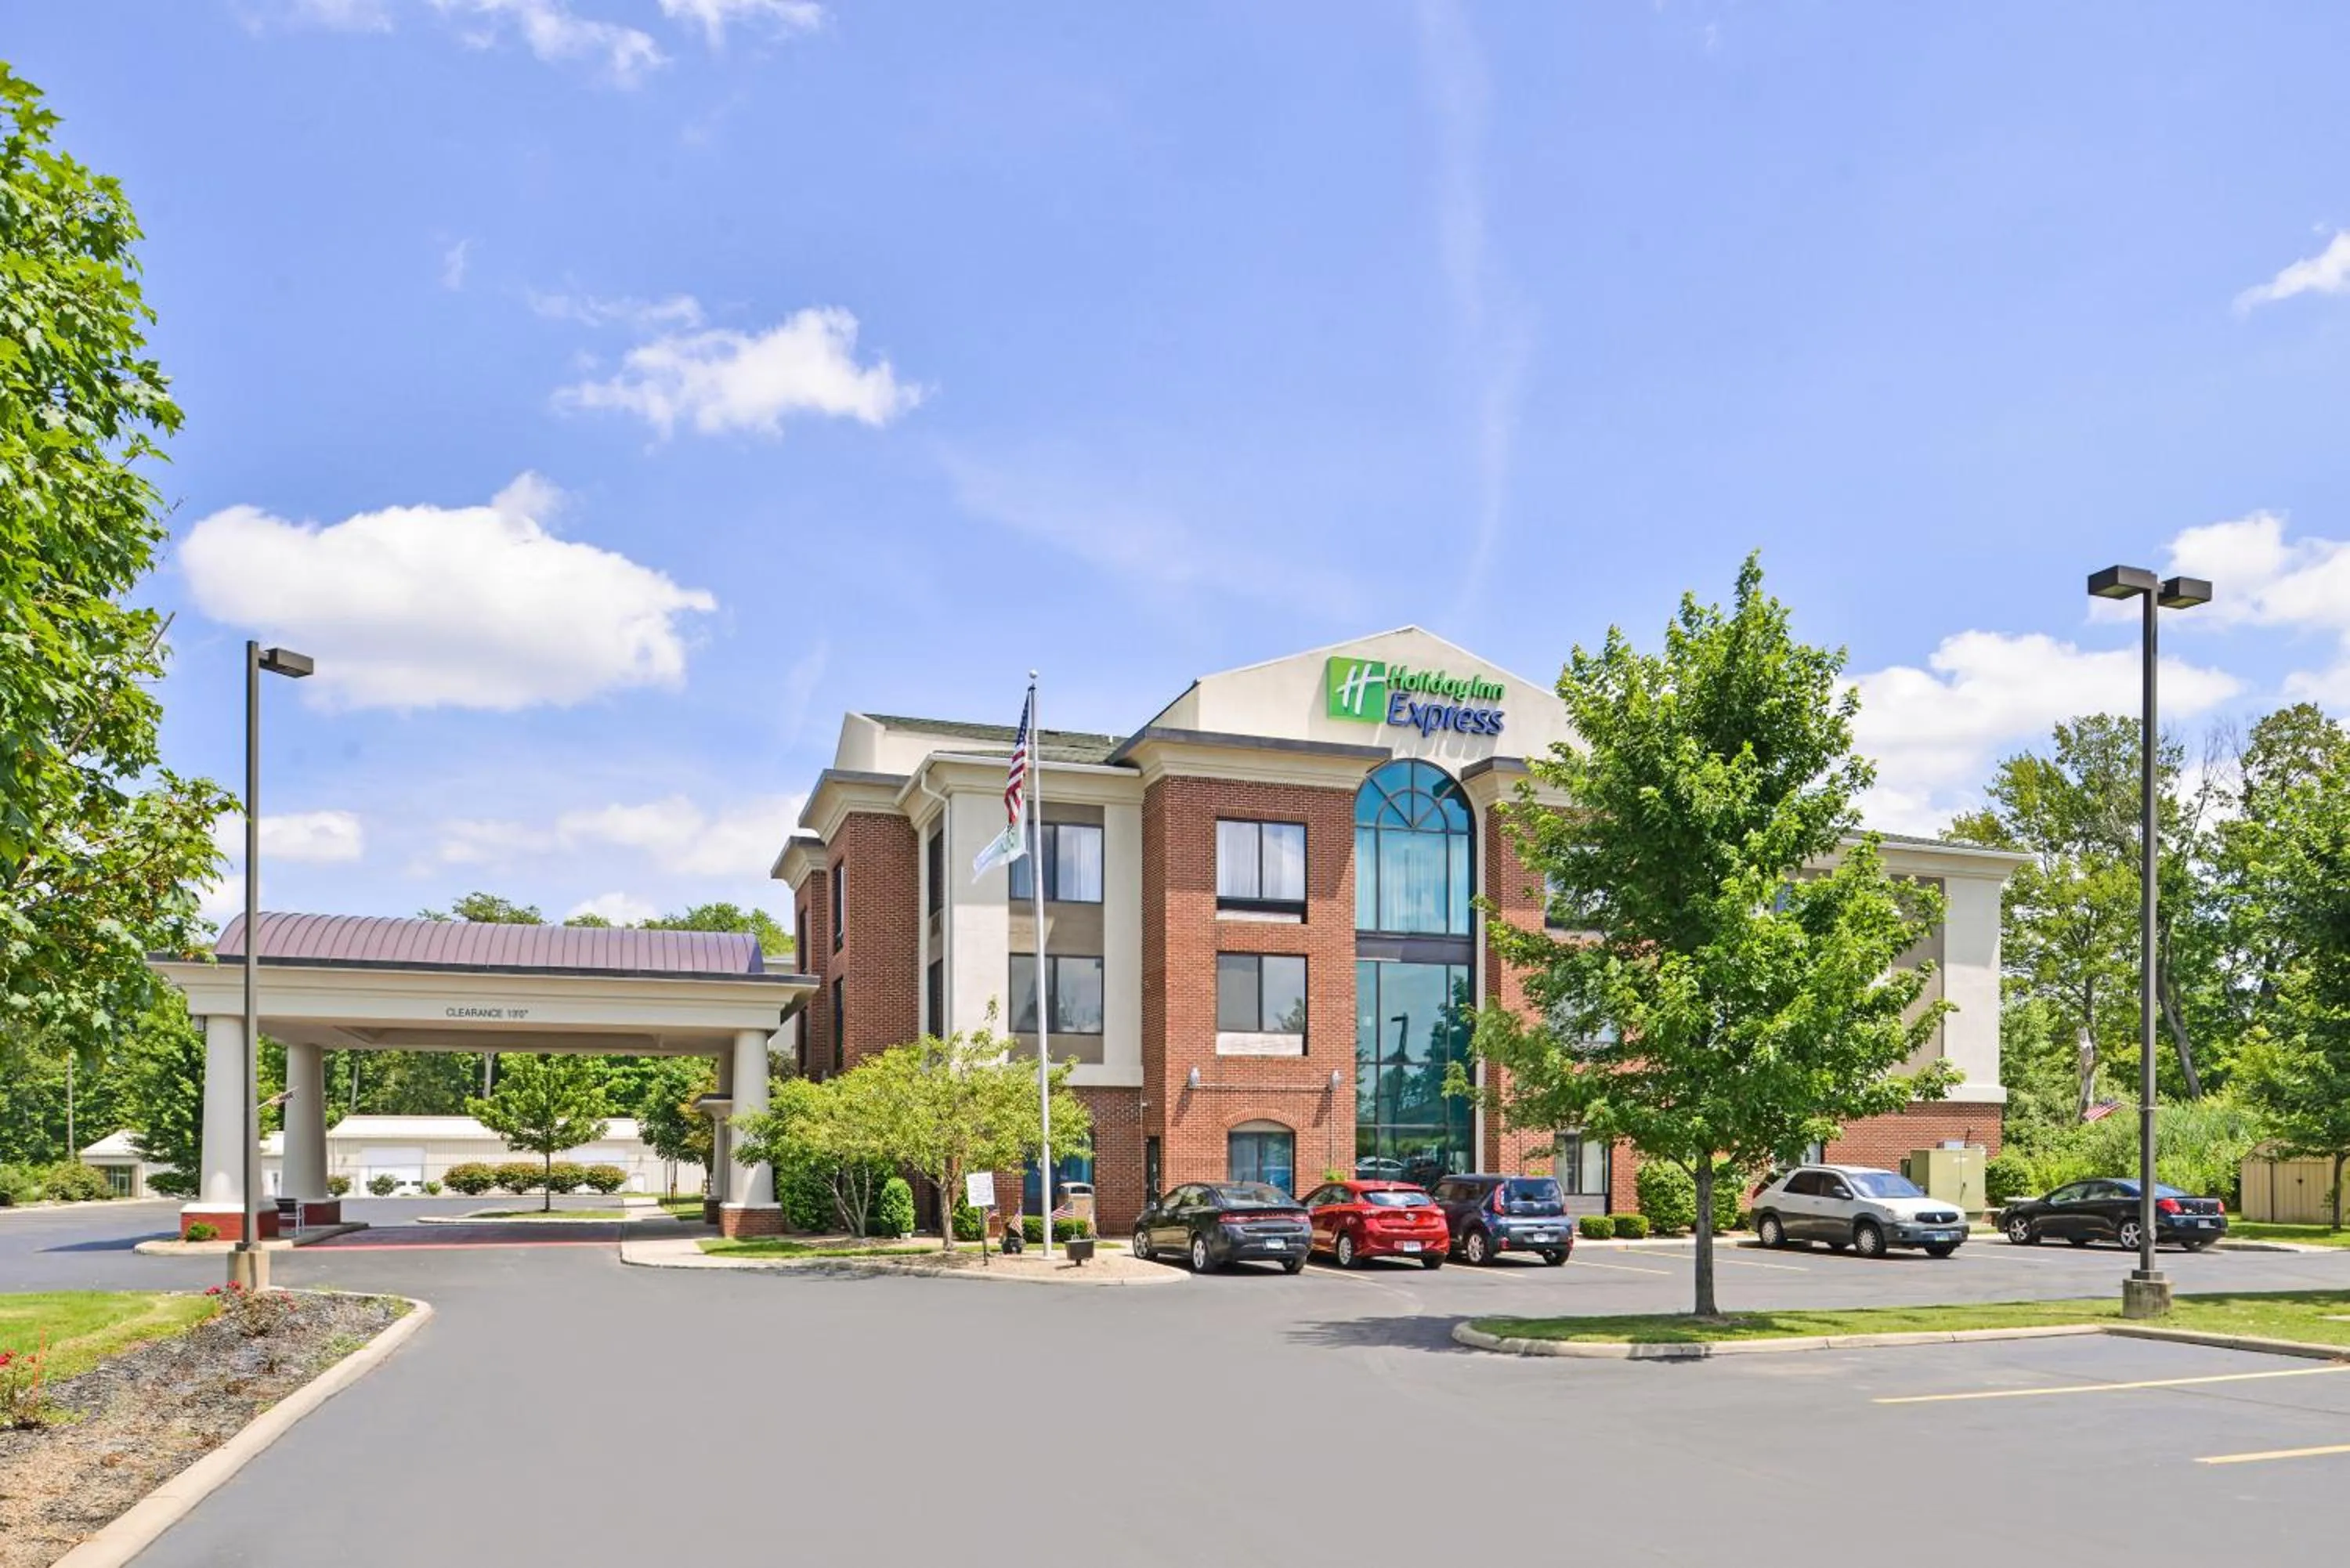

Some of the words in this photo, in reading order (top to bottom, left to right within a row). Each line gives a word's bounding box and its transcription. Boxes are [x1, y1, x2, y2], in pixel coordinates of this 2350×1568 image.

[1387, 665, 1470, 702] Holiday
[1470, 674, 1505, 700] Inn
[1386, 692, 1505, 738] Express
[446, 1007, 503, 1018] CLEARANCE
